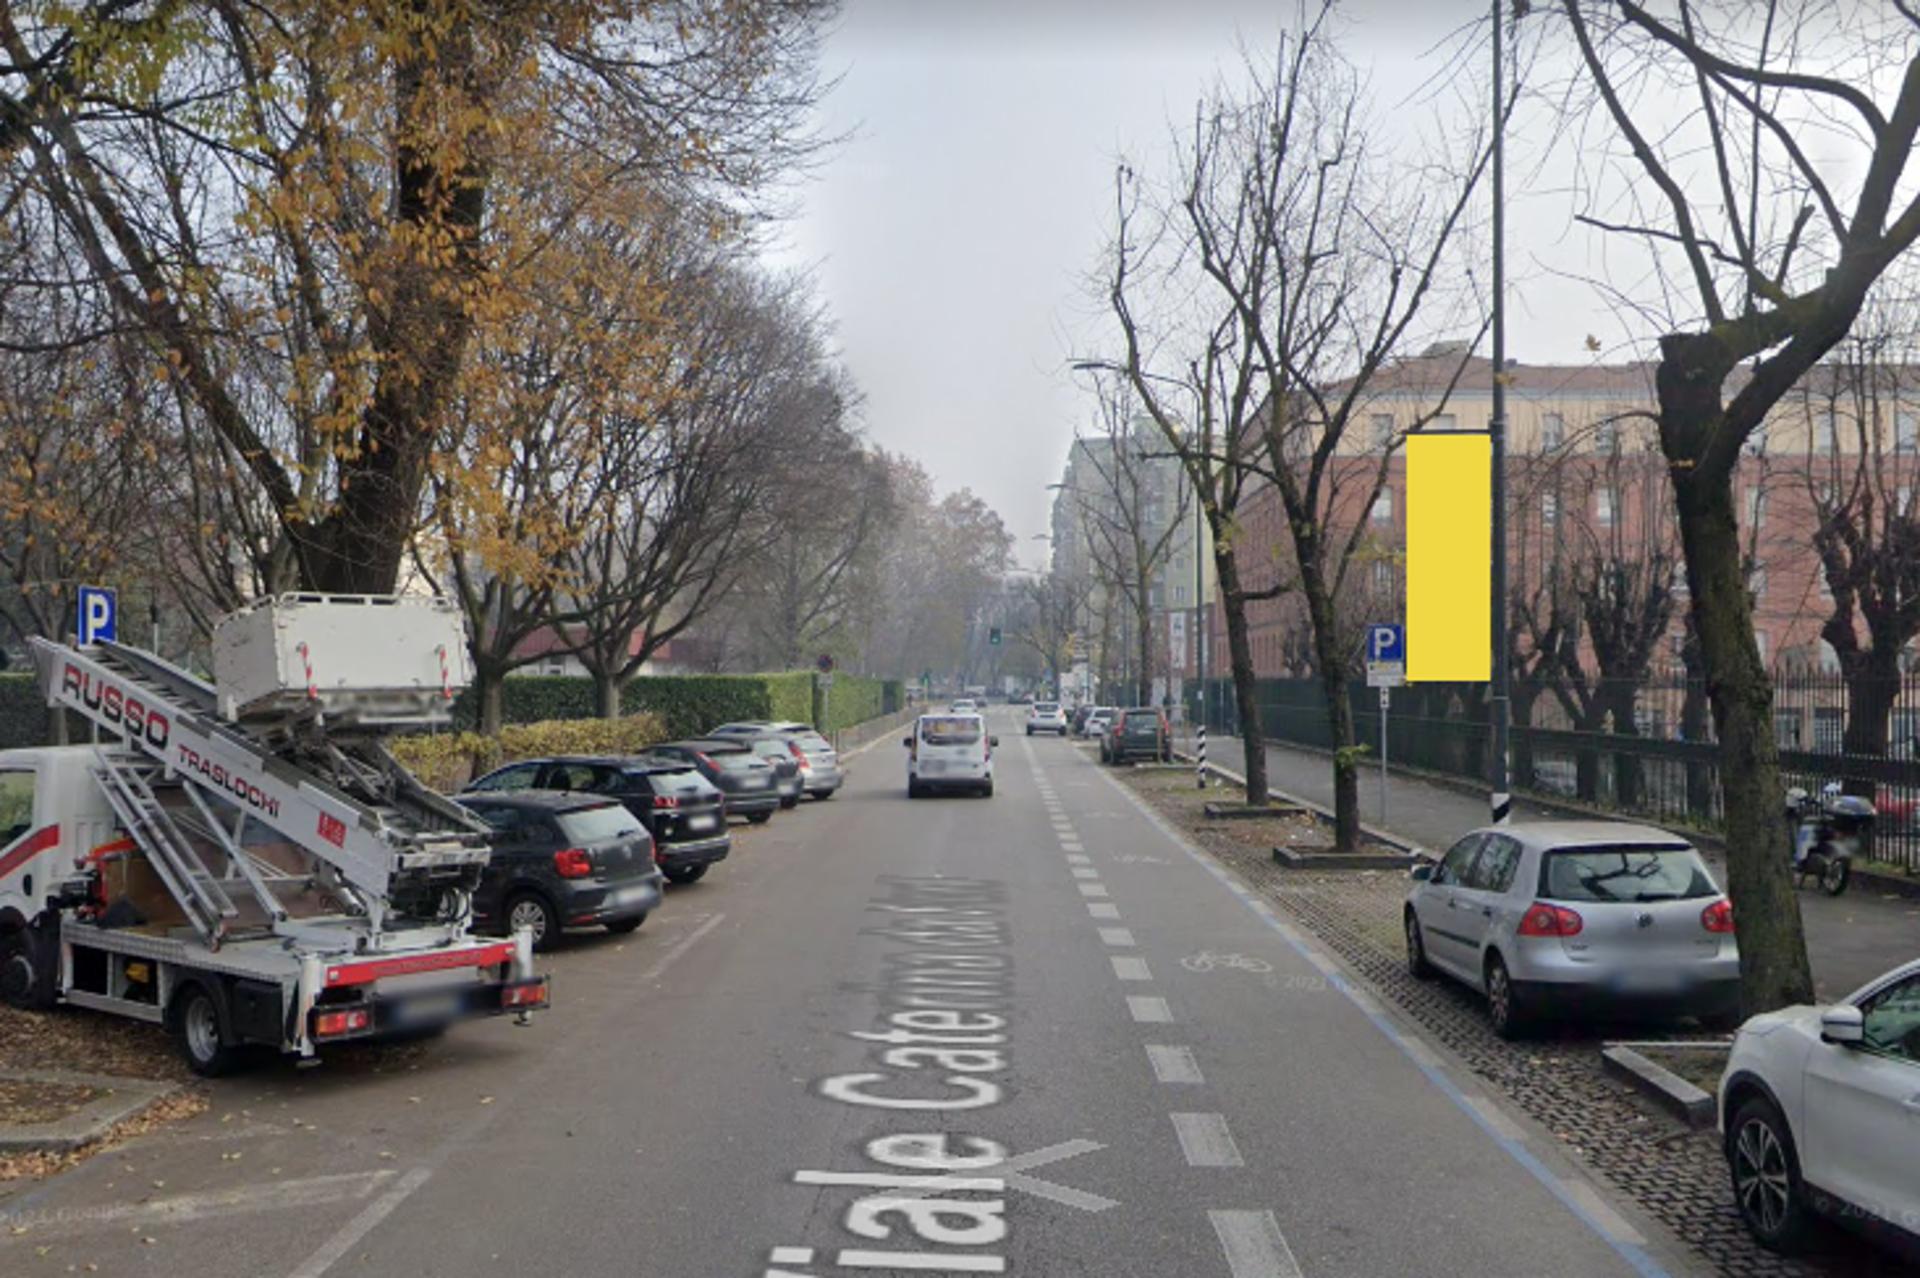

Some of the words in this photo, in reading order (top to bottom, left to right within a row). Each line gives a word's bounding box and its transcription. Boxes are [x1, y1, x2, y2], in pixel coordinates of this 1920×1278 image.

[87, 593, 109, 645] P
[1375, 628, 1395, 658] P
[62, 662, 170, 749] RUSSO
[177, 744, 280, 819] TRASLOCHI
